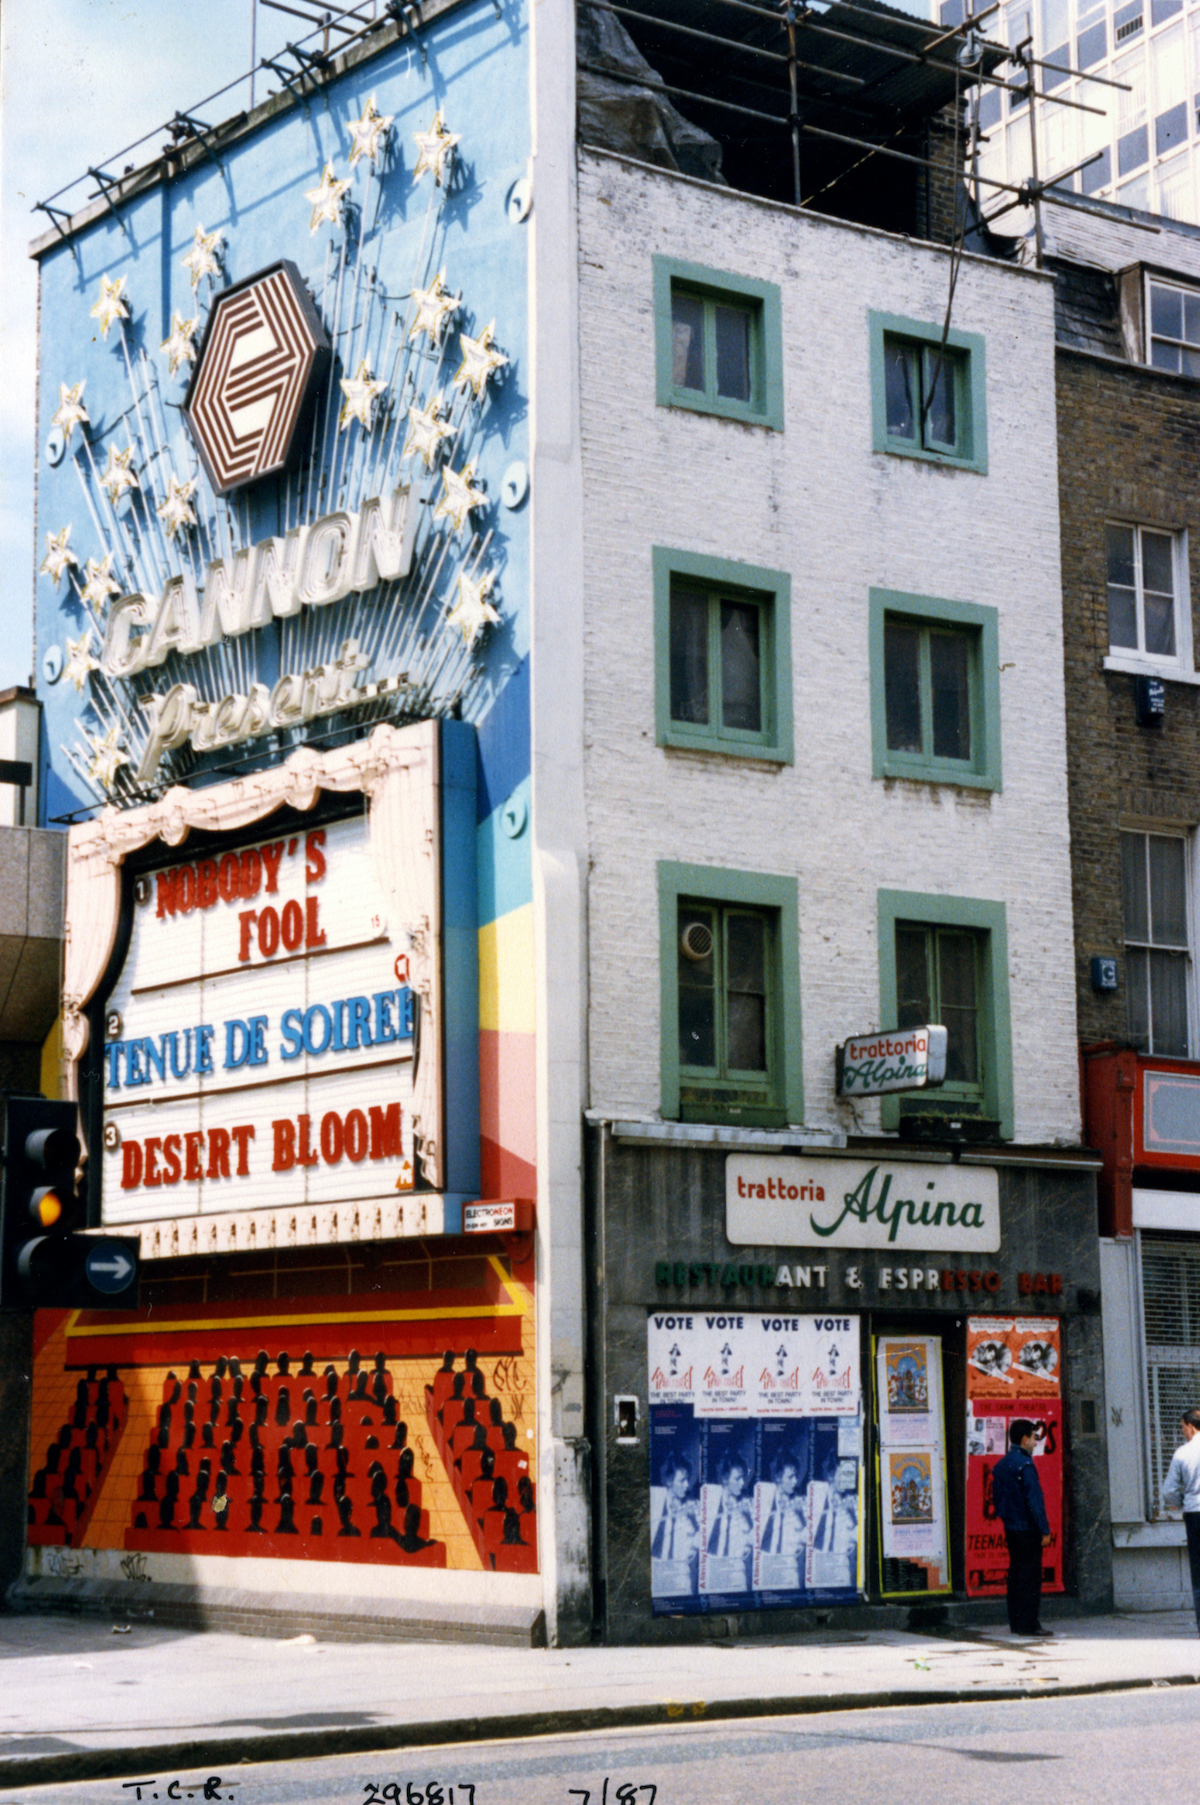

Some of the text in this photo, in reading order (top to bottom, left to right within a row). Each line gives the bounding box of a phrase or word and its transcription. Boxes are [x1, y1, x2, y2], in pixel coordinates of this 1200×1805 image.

[99, 483, 419, 677] CANNON
[155, 830, 327, 920] NOBODY'S
[136, 881, 145, 900] 1
[237, 896, 327, 962] FOOL
[108, 1015, 120, 1034] 2
[105, 986, 414, 1089] TENUE DE SOIREE
[850, 1034, 926, 1060] trattoria
[844, 1055, 927, 1088] Alpina
[105, 1127, 117, 1146] 3
[120, 1102, 402, 1190] DESERT BLOOM
[737, 1165, 985, 1242] trattoria Alpina
[655, 1263, 1063, 1295] RESTAURANT & ESPRESSO BAR
[654, 1316, 693, 1330] VOTE
[705, 1316, 744, 1329] VOTE
[762, 1318, 799, 1331] VOTE
[814, 1319, 850, 1331] VOTE
[701, 1553, 708, 1563] by
[754, 1551, 761, 1560] by
[807, 1549, 814, 1557] by
[754, 1578, 759, 1586] A
